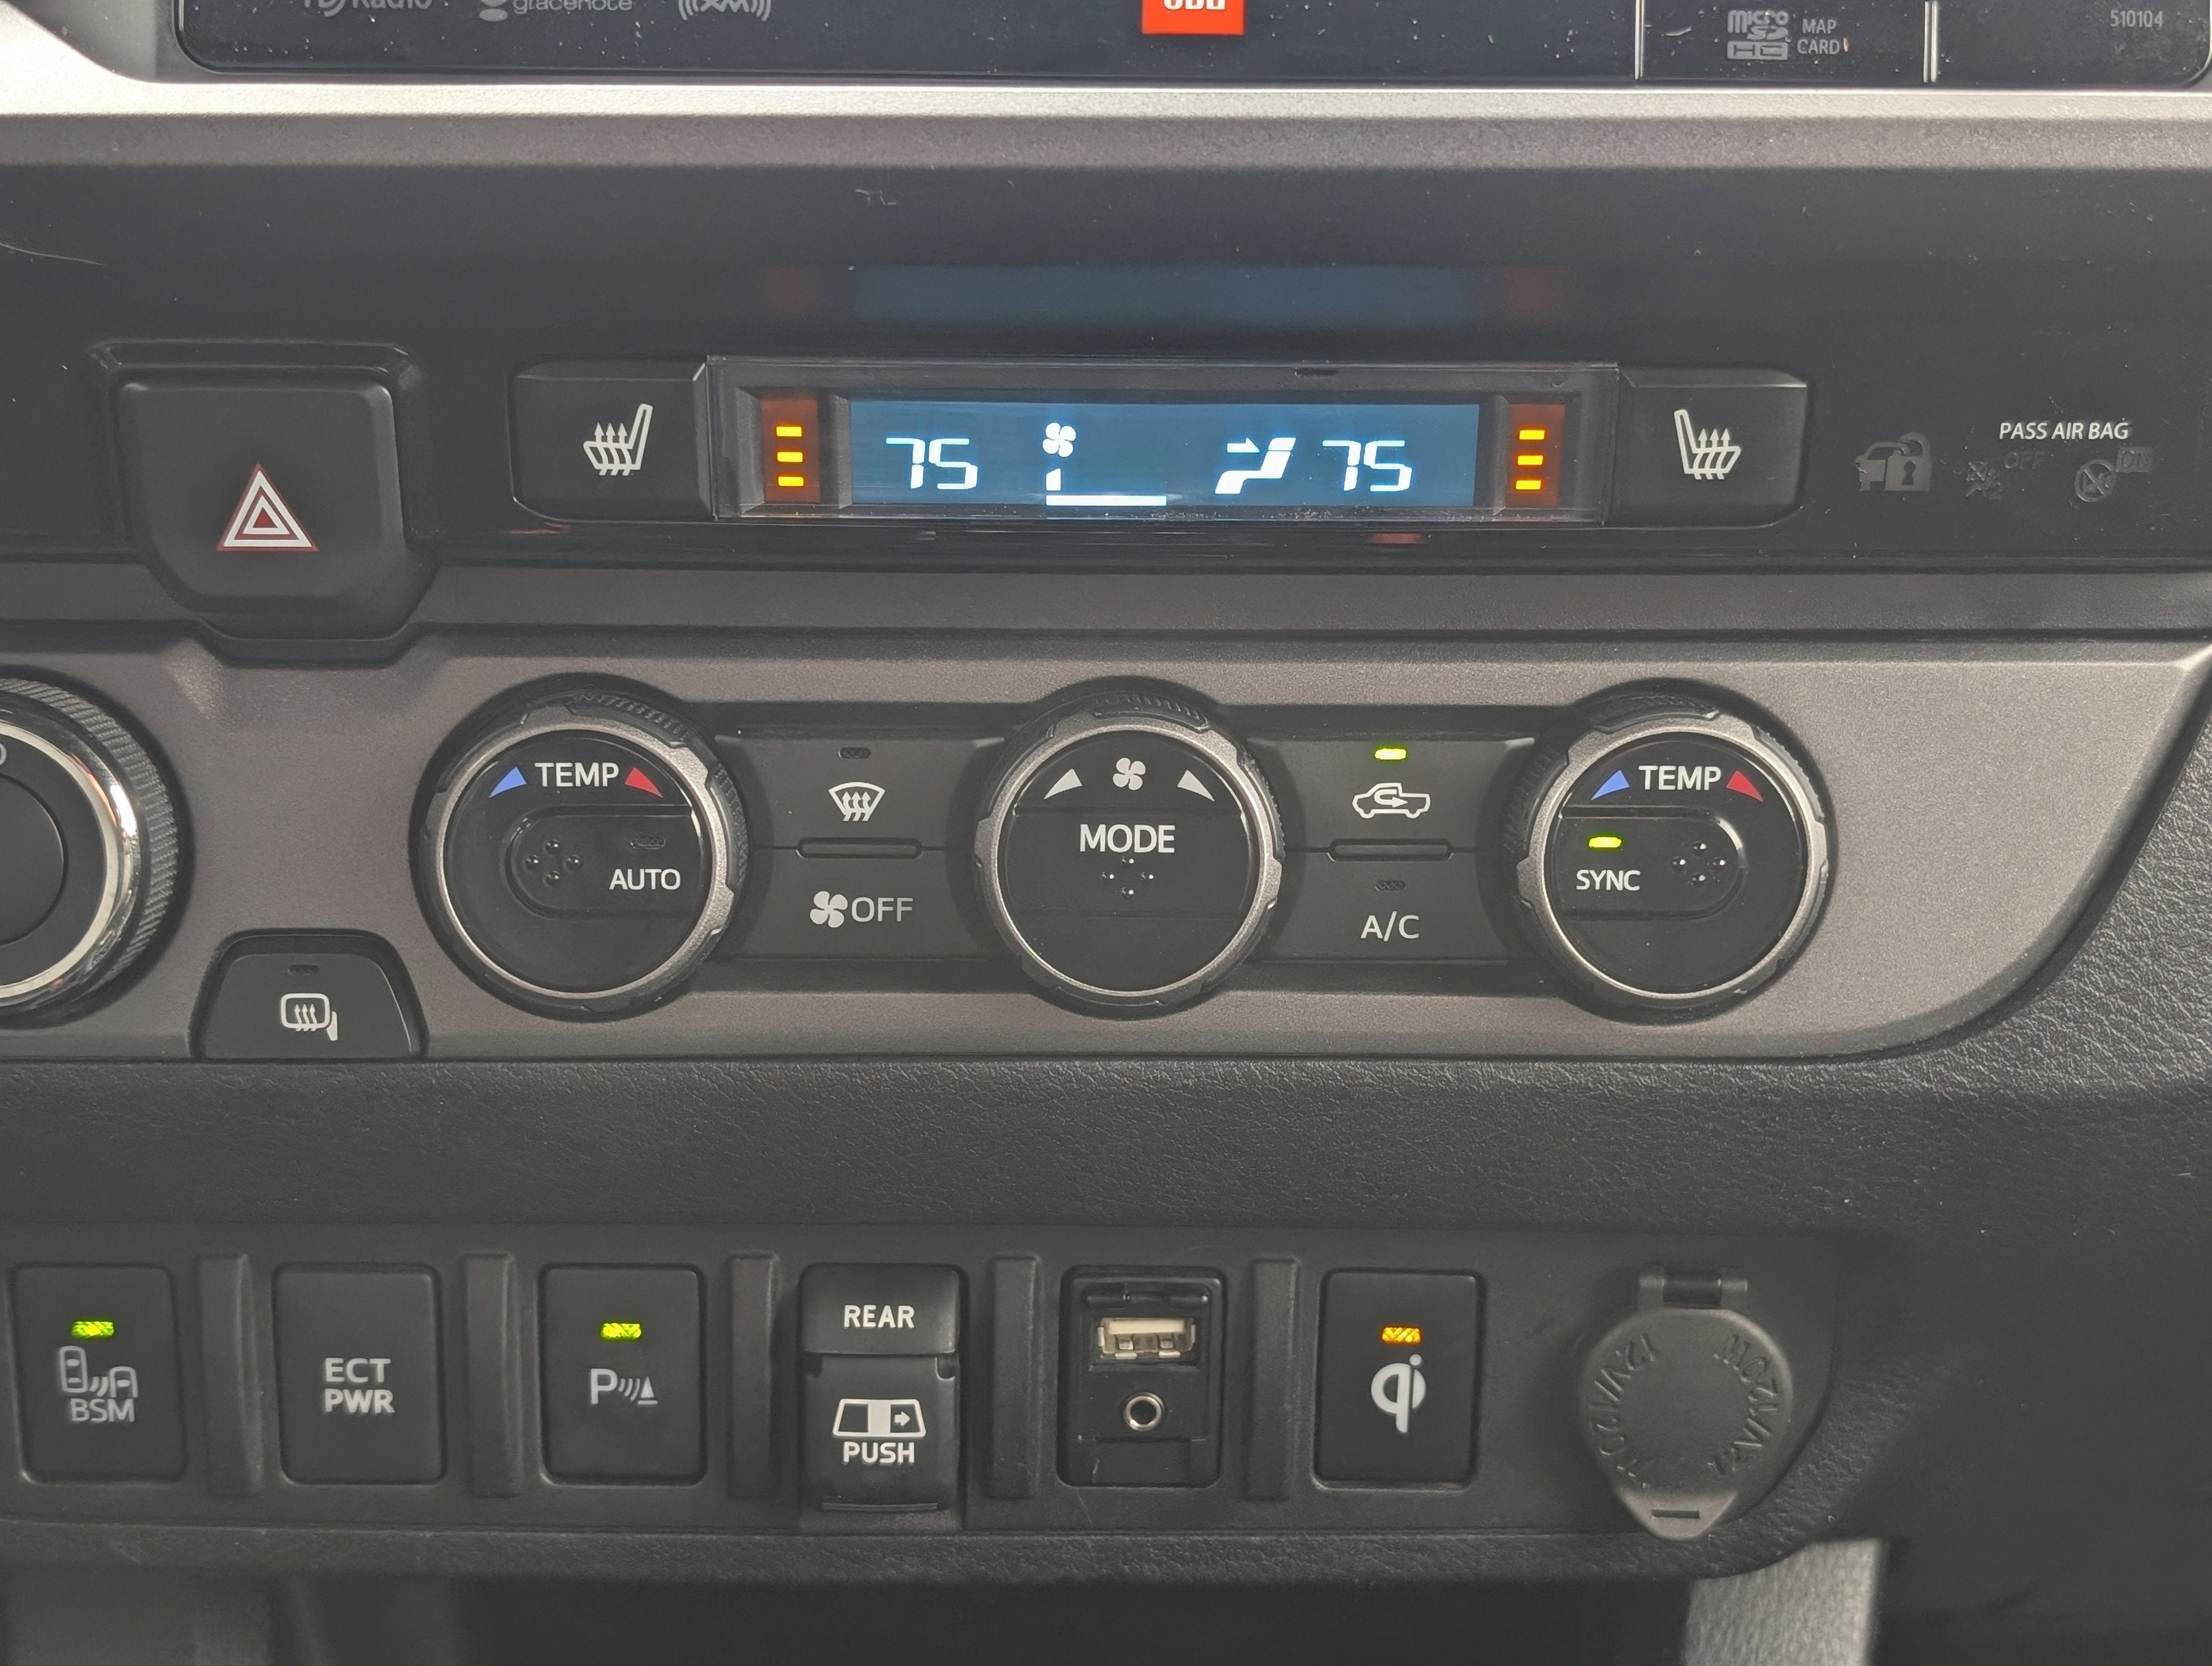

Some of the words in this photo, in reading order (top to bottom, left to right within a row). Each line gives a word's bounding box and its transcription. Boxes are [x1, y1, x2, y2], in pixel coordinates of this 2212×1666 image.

[1802, 18, 1837, 34] MAP
[2111, 10, 2163, 27] 510104
[1797, 39, 1840, 55] CARD
[1999, 422, 2048, 440] PASS
[2051, 422, 2084, 440] AIR
[2088, 422, 2129, 440] BAG
[886, 438, 978, 489] 75
[1322, 440, 1412, 492] 75
[535, 762, 619, 787] TEMP
[1638, 765, 1721, 791] TEMP
[1080, 824, 1175, 853] MODE
[609, 869, 680, 890] AUTO
[1576, 869, 1641, 891] SYNC
[851, 896, 914, 922] OFF
[1360, 911, 1419, 941] A/C
[844, 1305, 915, 1328] REAR
[325, 1357, 391, 1383] ECT
[70, 1398, 134, 1423] BSM
[324, 1389, 395, 1414] PWR
[843, 1441, 915, 1464] PUSH
